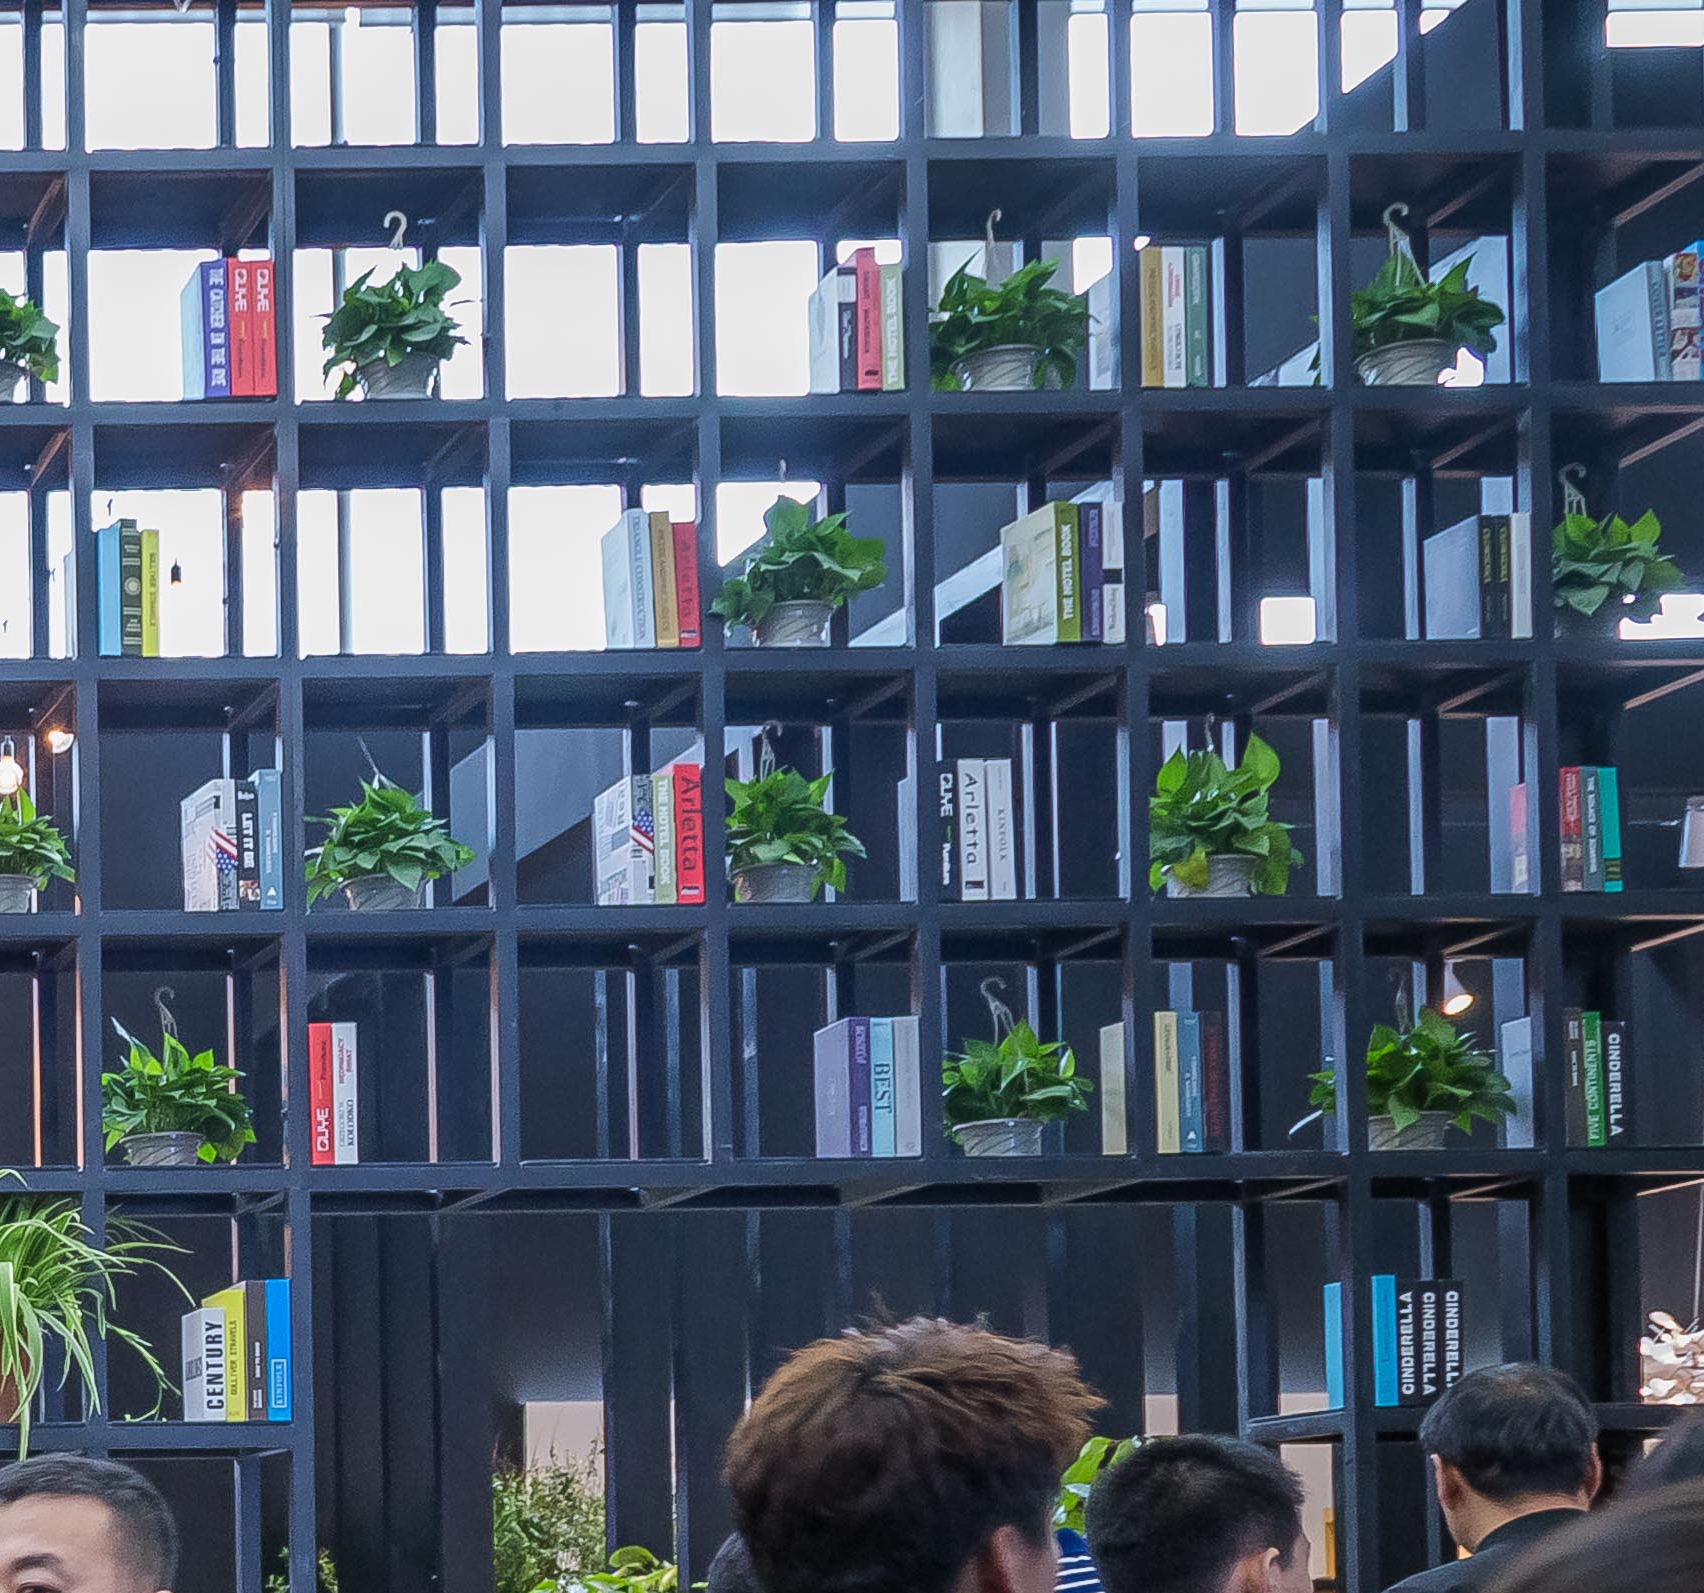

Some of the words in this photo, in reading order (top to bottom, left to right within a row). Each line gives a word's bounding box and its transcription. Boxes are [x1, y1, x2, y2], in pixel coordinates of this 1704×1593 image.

[1060, 524, 1072, 557] BOOK
[1061, 558, 1073, 595] HOTEL
[1062, 596, 1074, 621] THE
[657, 779, 668, 803] THE
[241, 813, 253, 835] LET
[658, 806, 669, 846] HOTEL
[681, 776, 701, 871] Arletta
[964, 773, 979, 864] Arletta
[659, 850, 670, 885] BOOK
[874, 1063, 893, 1114] BEST
[1584, 1039, 1599, 1109] CONTINENTS
[1607, 1033, 1624, 1137] CINDERELLA
[1587, 1113, 1599, 1140] FIVE
[1399, 1291, 1415, 1395] CINDERELLA
[1423, 1292, 1437, 1396] CINDERELLA
[1446, 1290, 1460, 1388] CINDERELL
[205, 1321, 224, 1410] CENTURY
